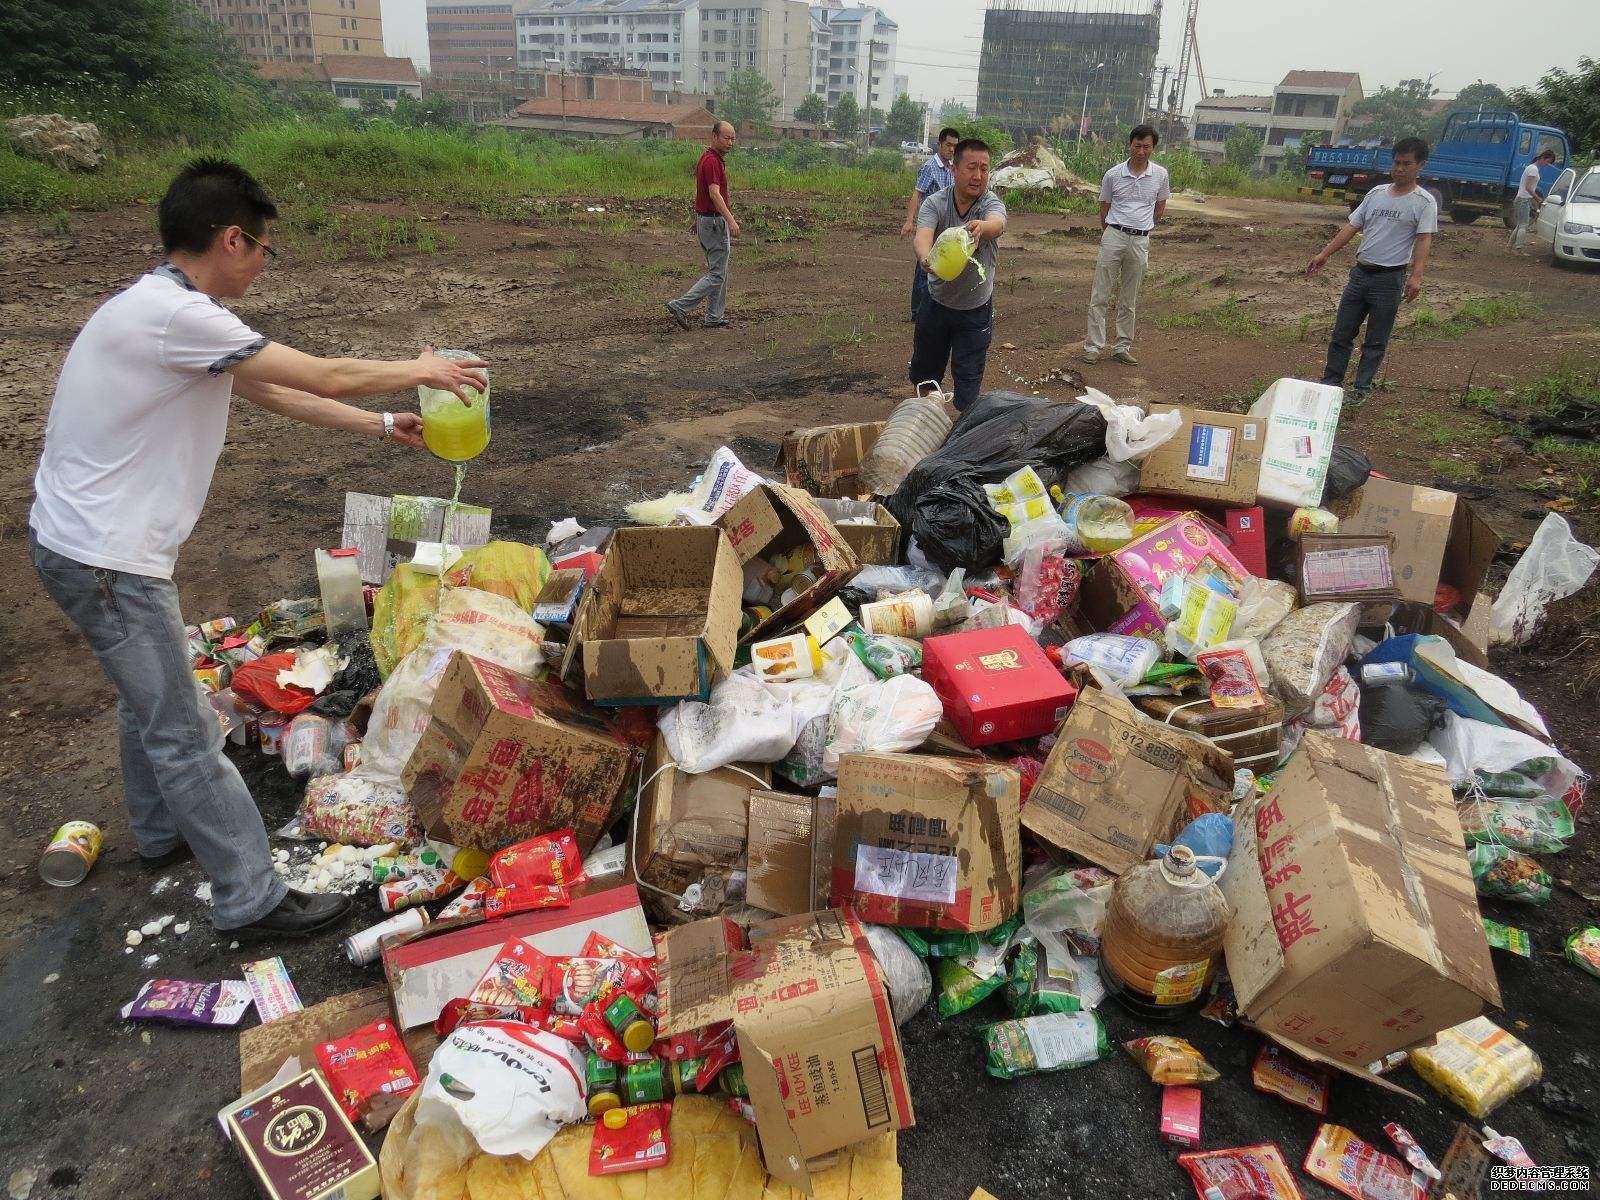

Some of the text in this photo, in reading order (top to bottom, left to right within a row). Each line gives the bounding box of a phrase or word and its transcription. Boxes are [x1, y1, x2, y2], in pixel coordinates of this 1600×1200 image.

[1121, 731, 1144, 749] 912
[786, 1051, 812, 1116] LEE KUM KEE
